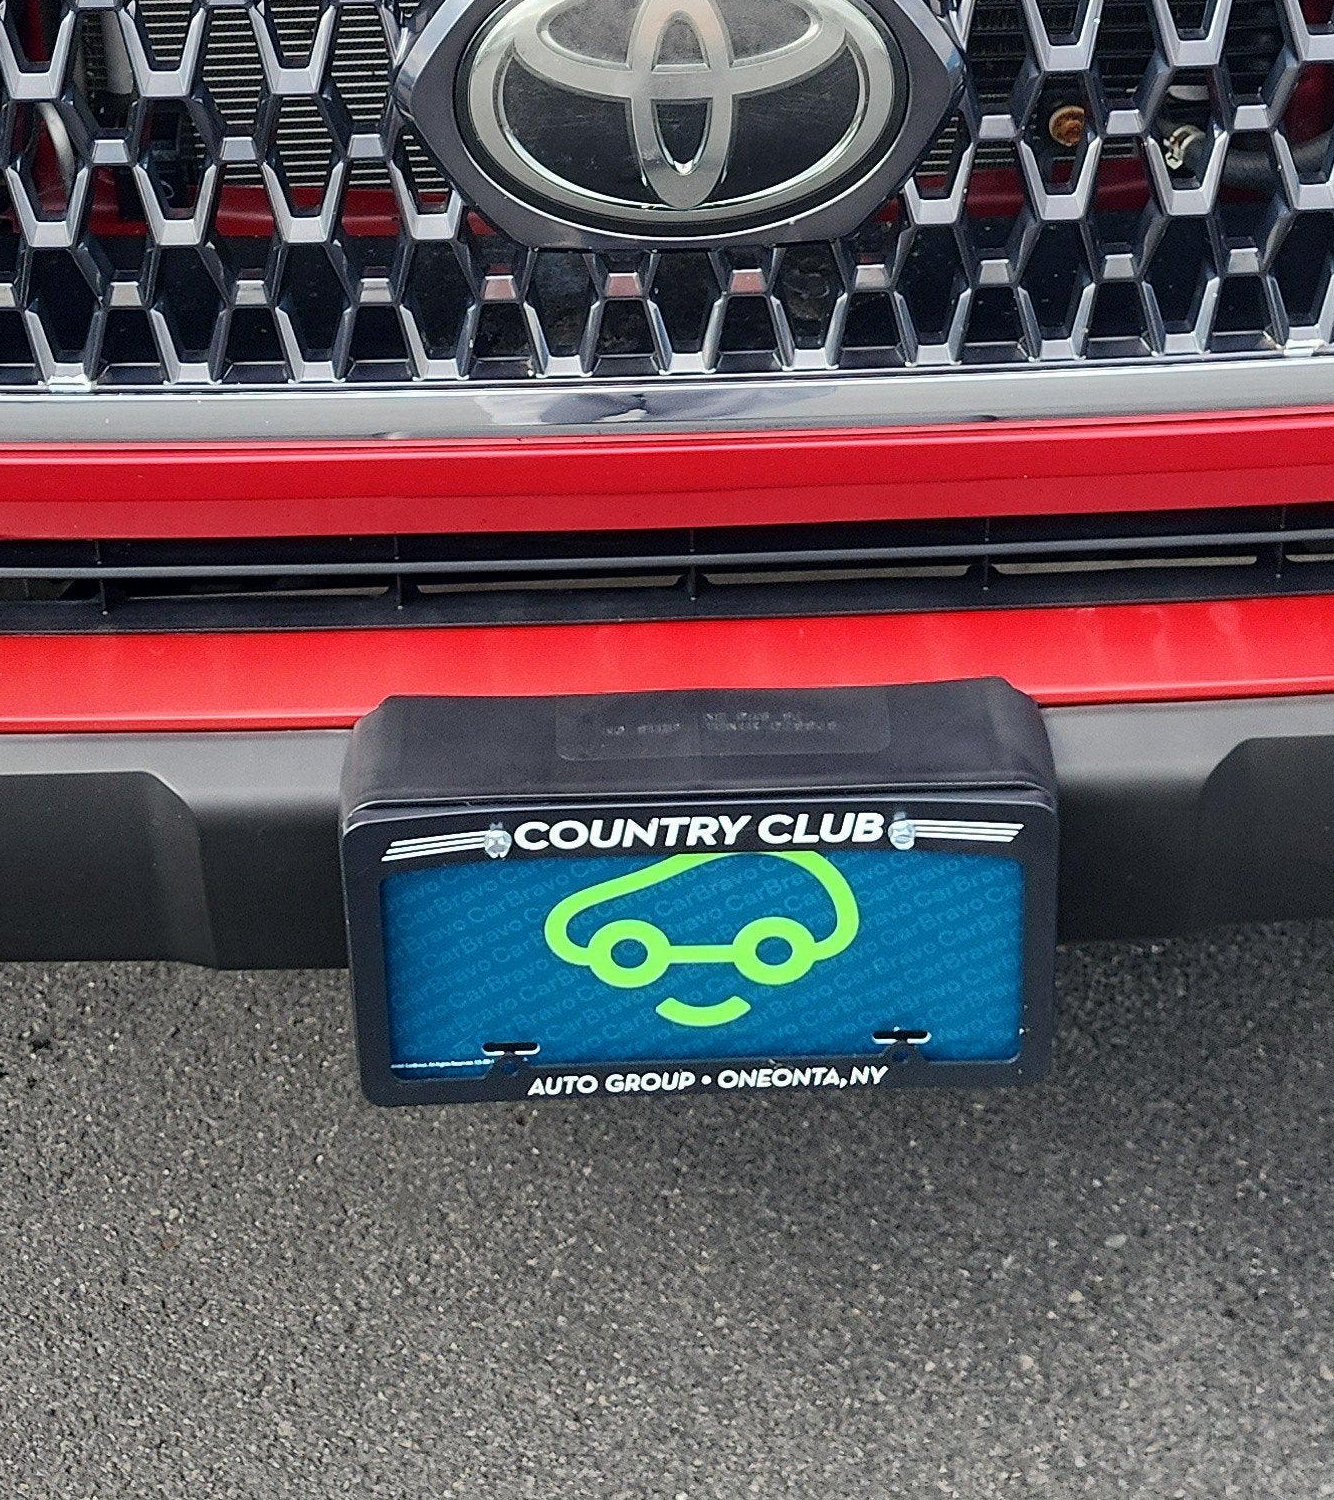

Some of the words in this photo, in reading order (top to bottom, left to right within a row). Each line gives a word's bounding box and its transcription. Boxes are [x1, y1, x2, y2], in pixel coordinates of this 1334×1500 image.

[514, 815, 752, 851] COUNTRY
[758, 812, 885, 845] CLUB
[527, 1075, 598, 1095] AUTO
[605, 1071, 695, 1093] GROUP
